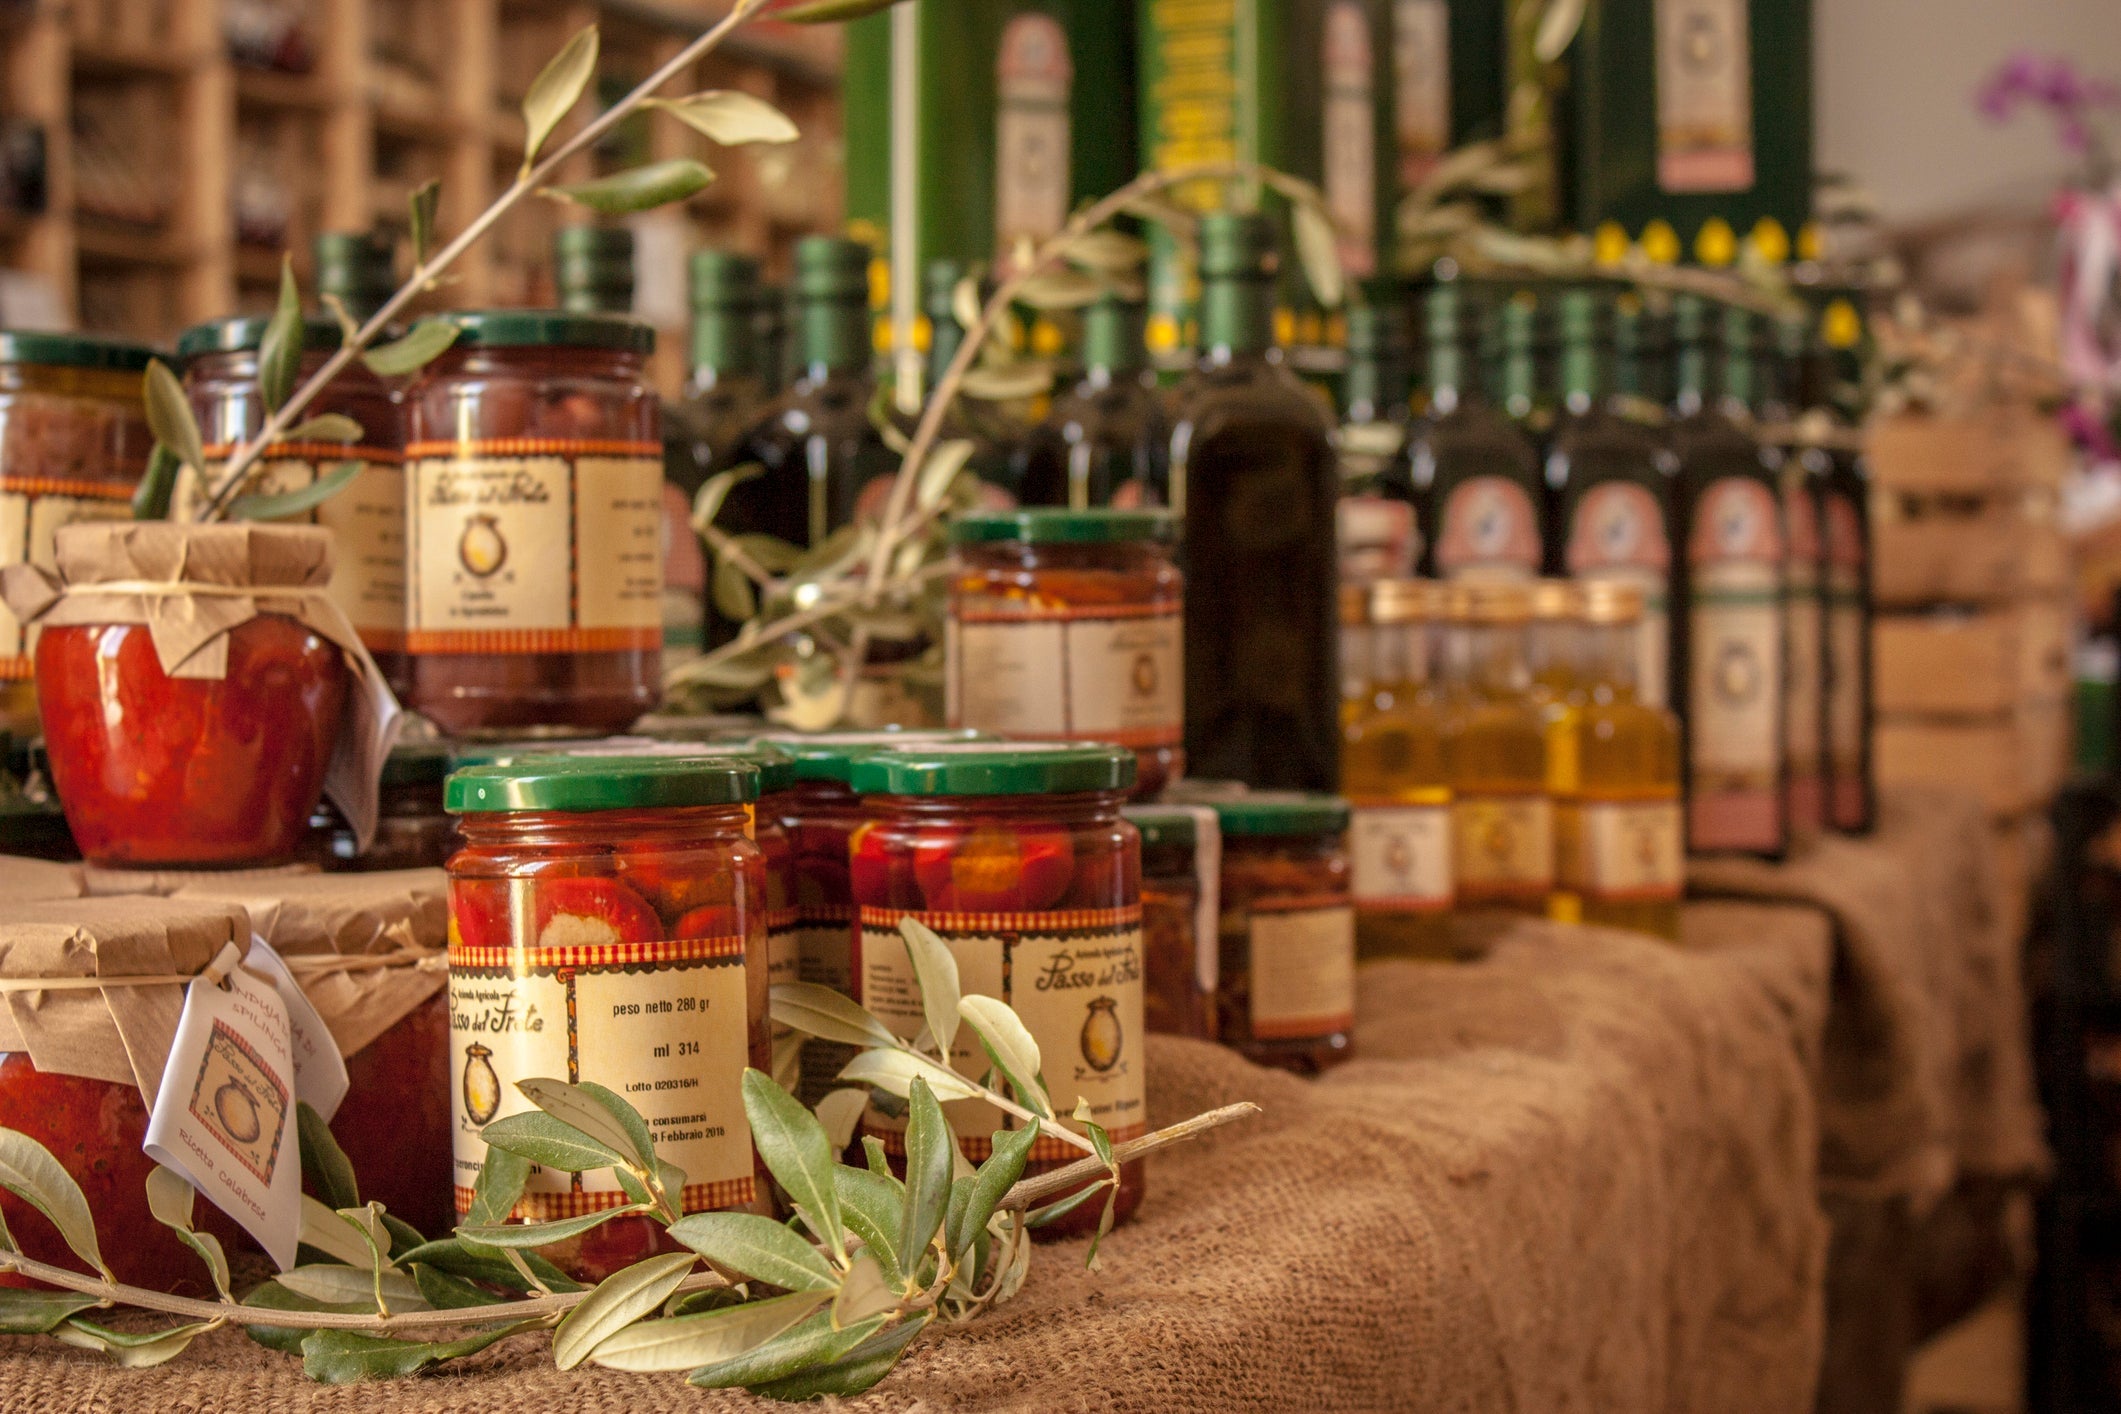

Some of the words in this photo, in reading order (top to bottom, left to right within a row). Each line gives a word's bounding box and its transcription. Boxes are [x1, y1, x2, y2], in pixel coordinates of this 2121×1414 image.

[1036, 949, 1095, 991] Passo
[612, 1003, 641, 1018] peso
[644, 999, 673, 1014] netto
[676, 997, 696, 1012] 280
[699, 998, 710, 1013] gr
[653, 1043, 670, 1058] ml
[678, 1041, 700, 1056] 314
[625, 1081, 652, 1092] Lotto
[654, 1078, 699, 1091] 020316/H
[652, 1112, 707, 1127] consumarsi
[660, 1128, 704, 1143] Febbraio
[178, 1127, 215, 1170] Ricetta
[218, 1169, 267, 1222] Calabrese
